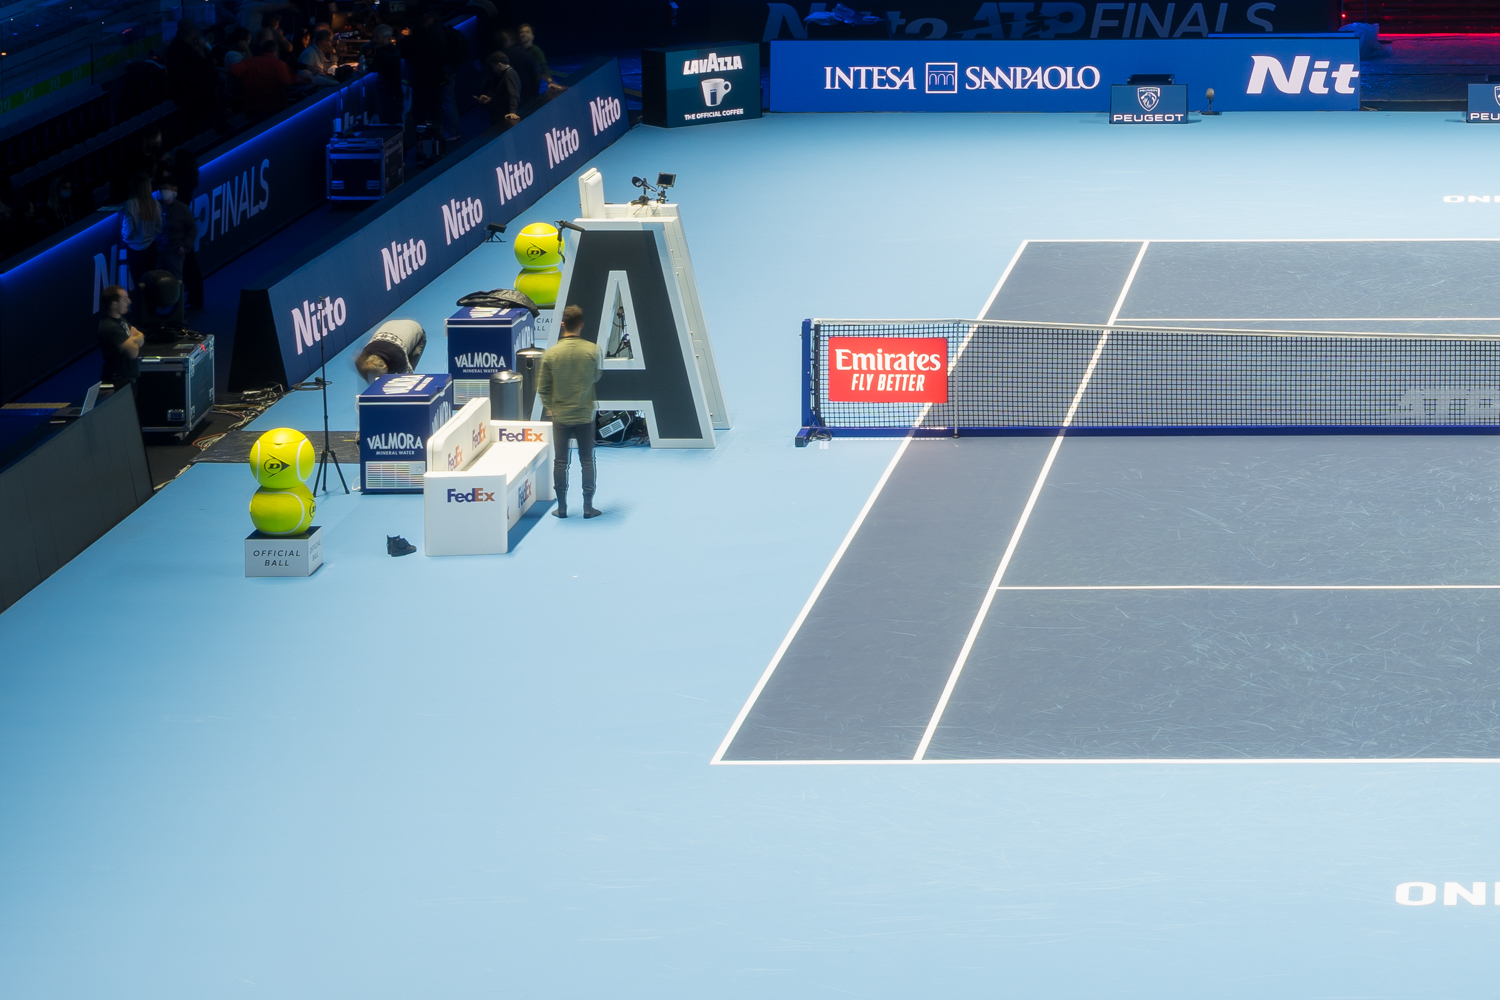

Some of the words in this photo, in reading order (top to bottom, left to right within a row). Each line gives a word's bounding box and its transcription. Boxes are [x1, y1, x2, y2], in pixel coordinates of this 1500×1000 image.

[762, 2, 948, 41] Nto
[683, 53, 743, 75] LAVAZZA
[1246, 55, 1360, 95] Nit
[824, 65, 917, 91] INTESA
[965, 65, 1101, 91] SANPAOLO
[589, 96, 621, 136] Nitto
[696, 111, 722, 119] OFFICIAL
[722, 108, 744, 116] COFFEE
[1113, 114, 1184, 122] PEUGEOT
[545, 127, 580, 169] Nitto
[495, 160, 534, 206] Nitto
[210, 158, 270, 242] FINALS
[441, 197, 483, 246] Nitto
[381, 238, 427, 291] Nitto
[291, 296, 347, 355] Nitto
[455, 352, 507, 368] VALMORA
[835, 348, 941, 371] Emirates
[851, 373, 874, 391] FLY
[877, 373, 925, 391] BETTER
[366, 432, 424, 450] VALMORA
[472, 421, 486, 451] FedEx
[499, 428, 544, 442] FedEx
[447, 445, 463, 471] FedEx
[447, 487, 496, 503] FedEx
[264, 559, 290, 567] BALL
